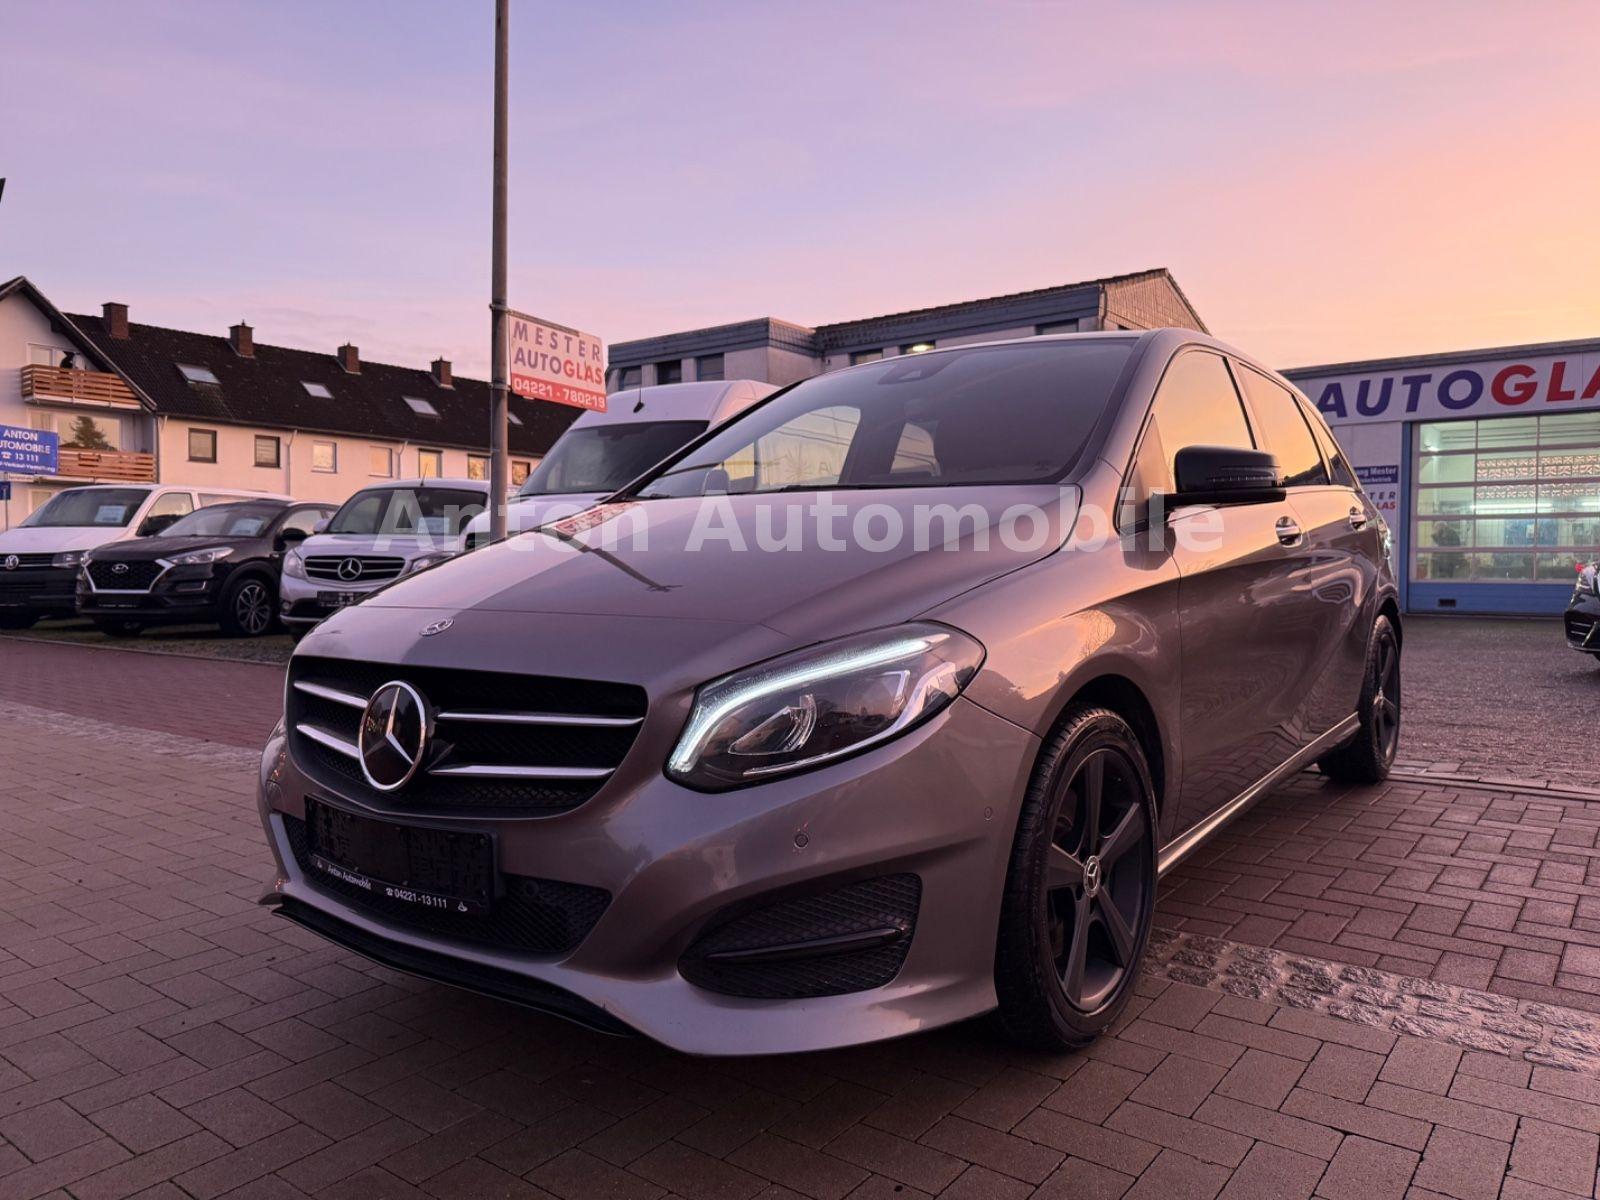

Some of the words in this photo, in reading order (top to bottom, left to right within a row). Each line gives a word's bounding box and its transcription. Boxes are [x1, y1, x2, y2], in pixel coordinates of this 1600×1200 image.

[513, 321, 600, 361] MESTER
[514, 347, 602, 385] AUTOGLAS
[514, 378, 553, 397] 04221
[562, 388, 605, 408] 780219
[3, 429, 38, 441] ANTON
[15, 452, 24, 461] 13
[26, 454, 39, 463] 111
[327, 865, 342, 878] Anton
